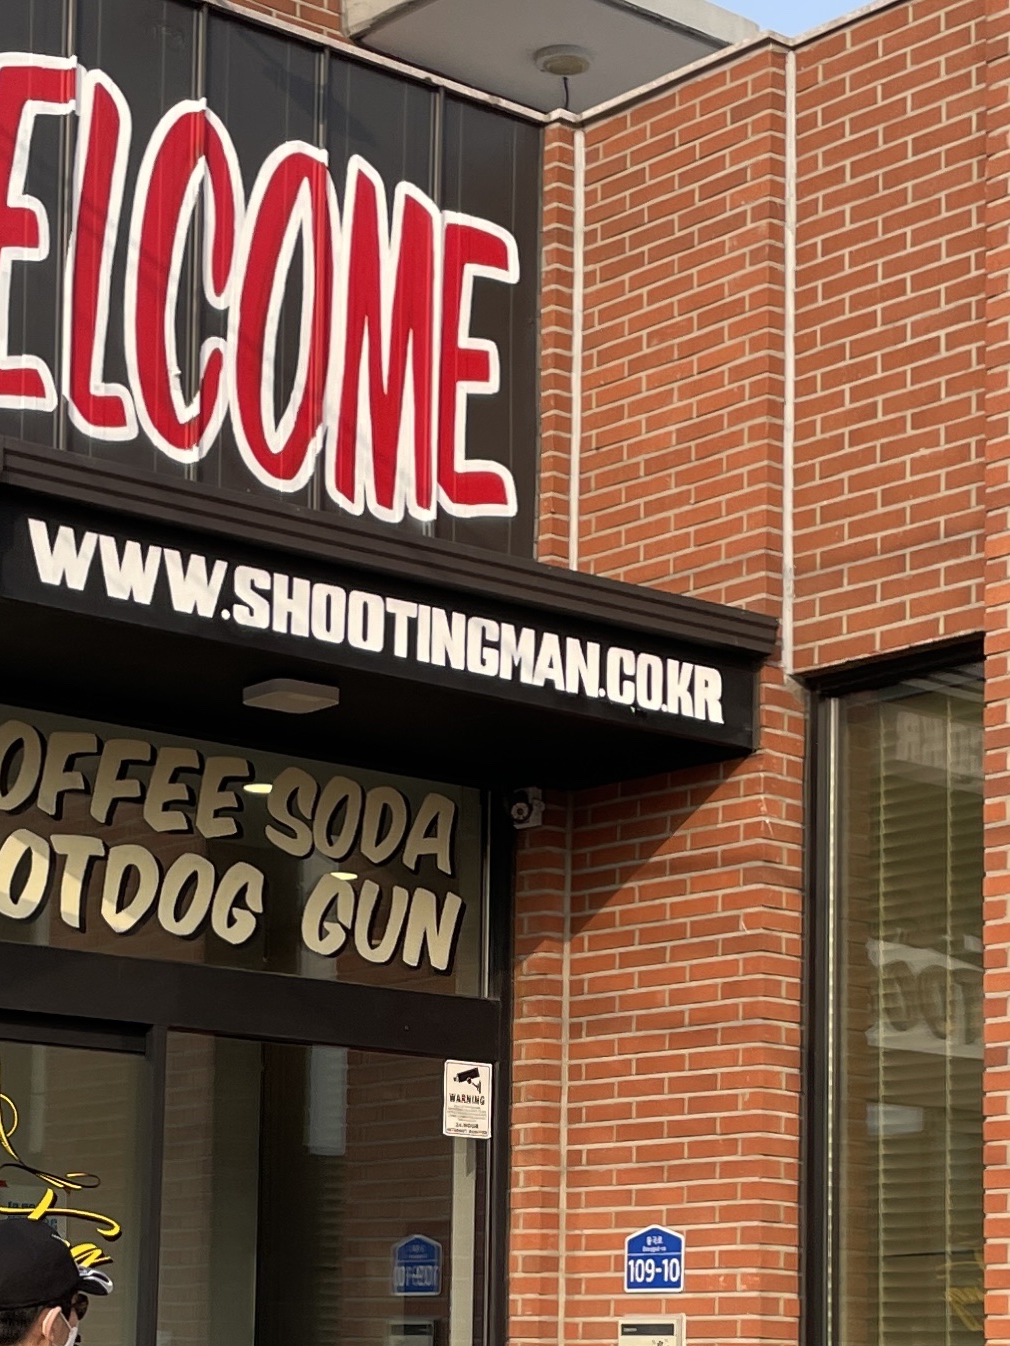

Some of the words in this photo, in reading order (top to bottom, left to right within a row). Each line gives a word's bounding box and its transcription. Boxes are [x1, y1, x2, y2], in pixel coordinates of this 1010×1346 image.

[28, 518, 725, 725] WWW.SHOOTINGMAN.CO.KR
[265, 766, 455, 875] SODA
[301, 873, 465, 971] GUN
[449, 1093, 485, 1106] WARNING
[628, 1257, 680, 1283] 109-10
